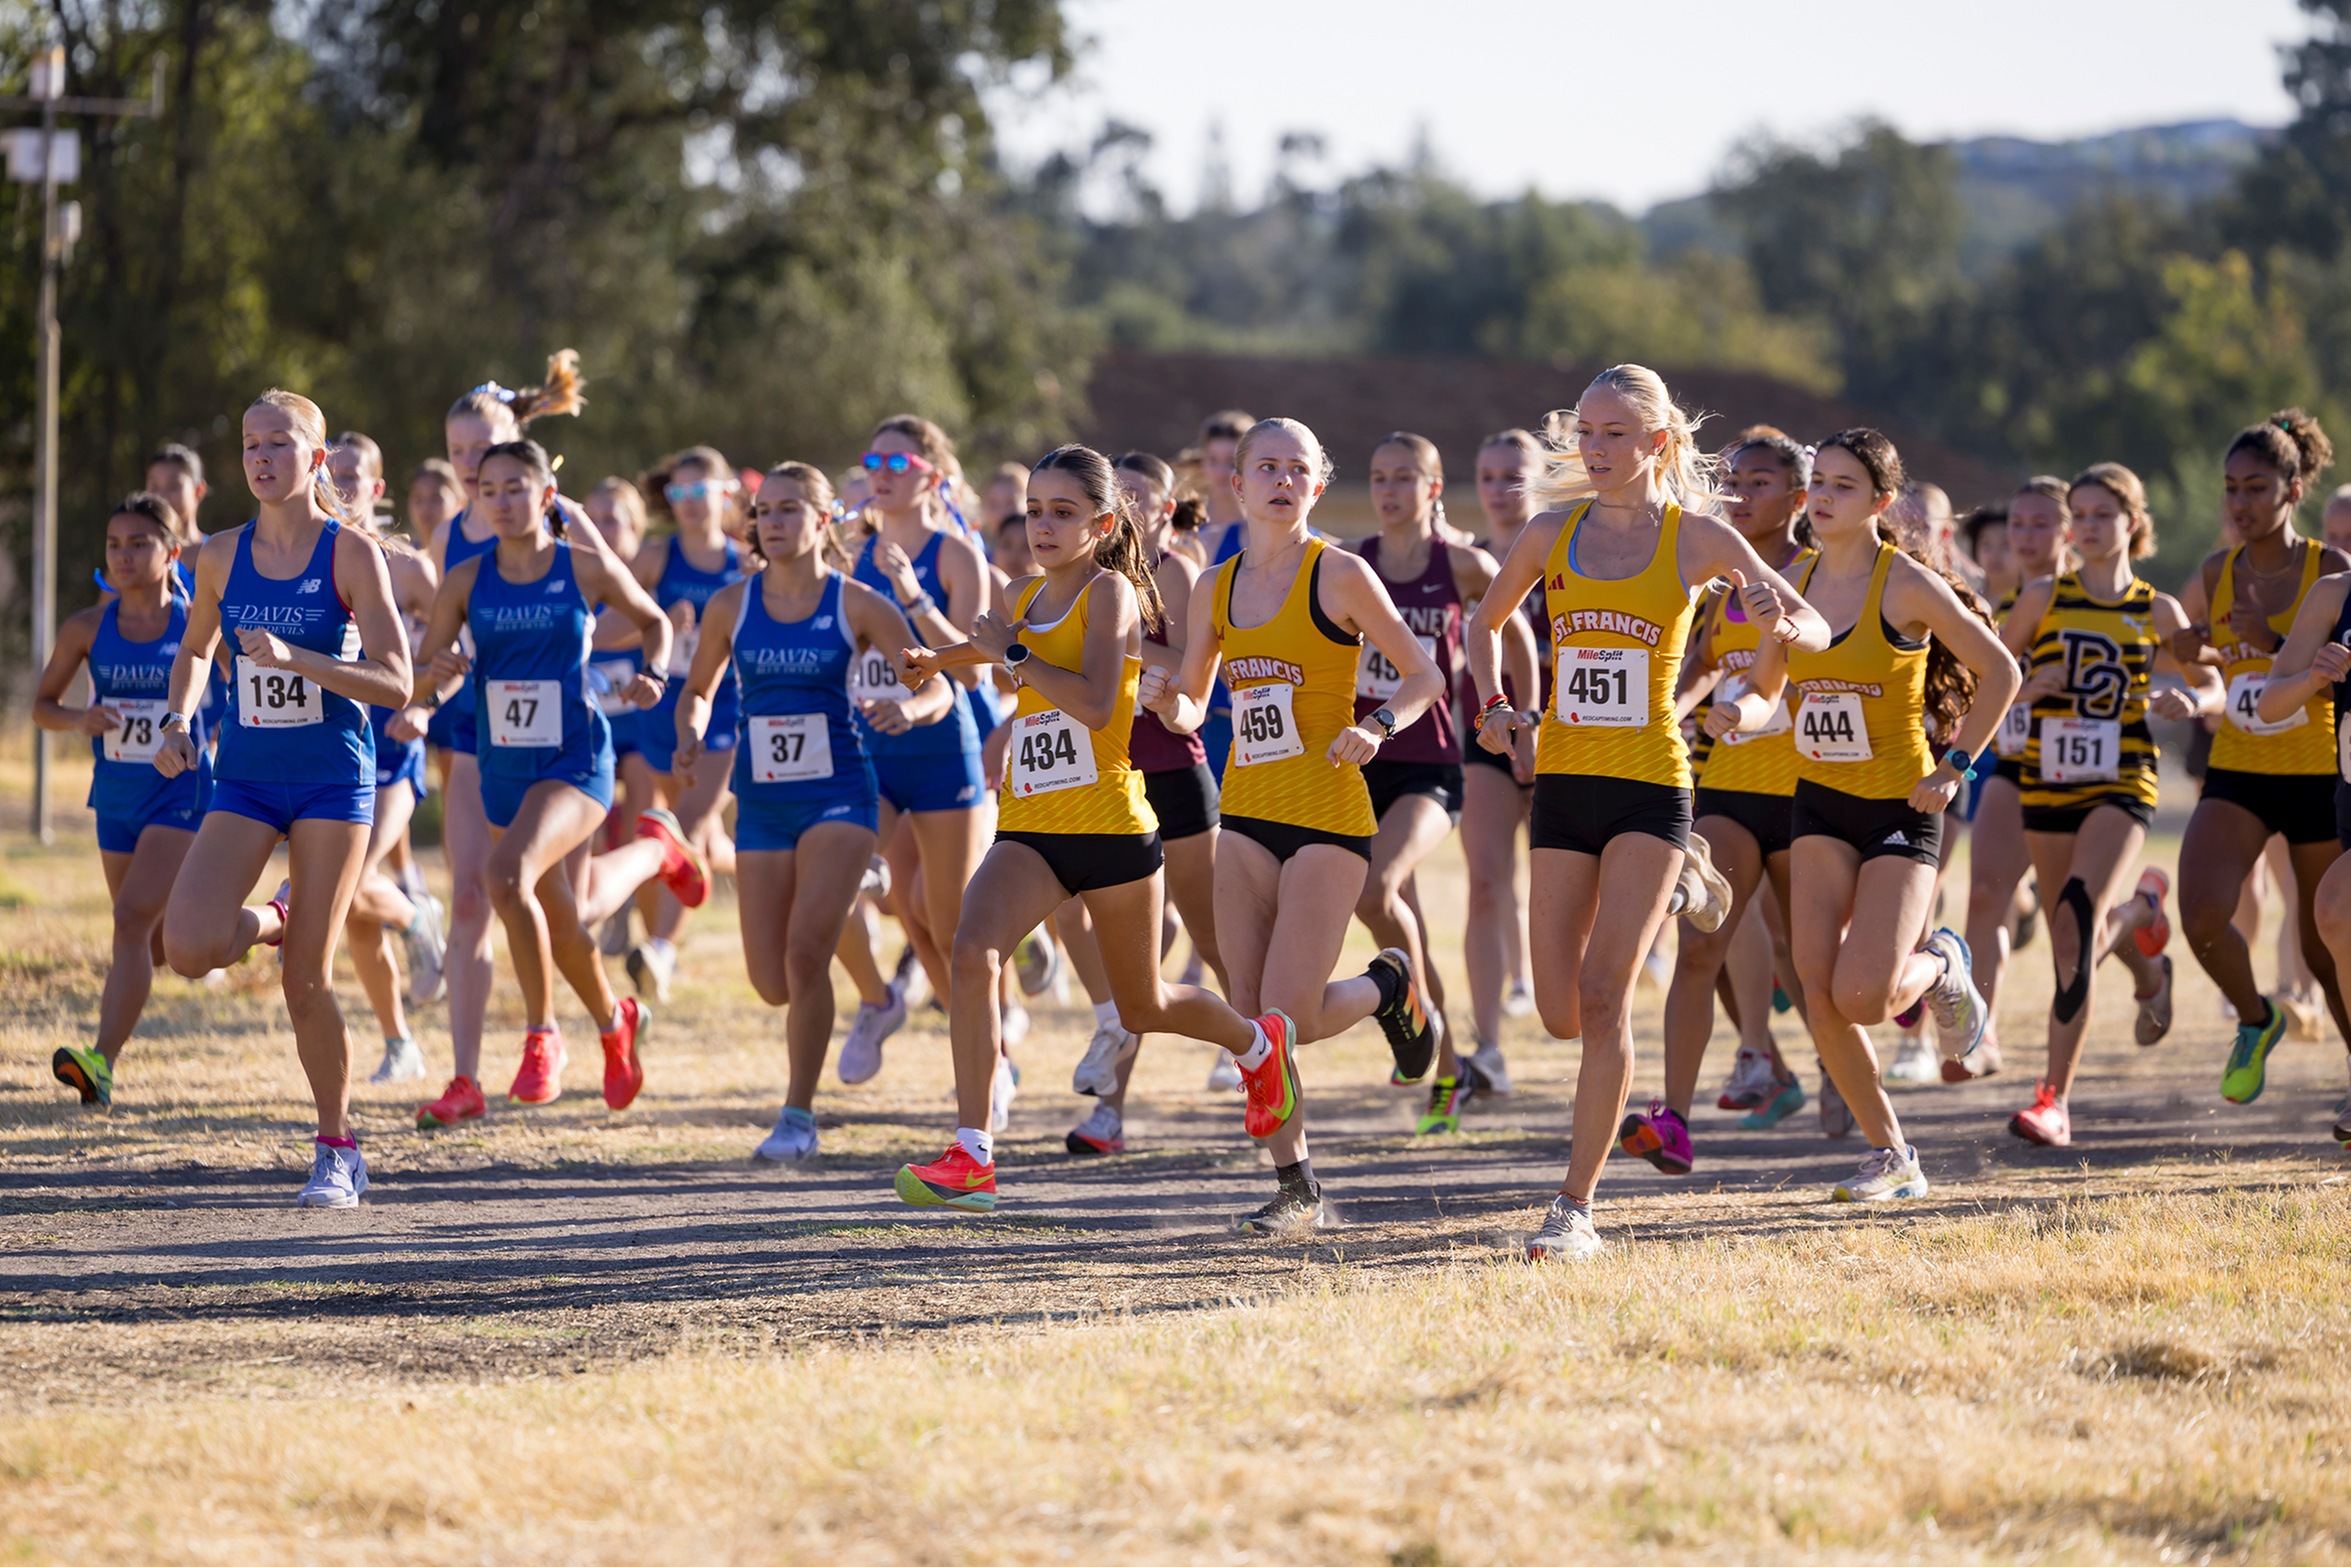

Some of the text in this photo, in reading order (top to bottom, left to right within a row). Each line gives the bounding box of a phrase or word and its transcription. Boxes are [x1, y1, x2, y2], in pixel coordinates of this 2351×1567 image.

[239, 604, 305, 623] DAVIS
[496, 604, 552, 622] DAVIS
[1553, 610, 1663, 647] ST. FRANCIS
[757, 647, 819, 664] DAVIS
[1576, 649, 1624, 662] MileSplit
[112, 664, 166, 680] DAVIS
[1228, 657, 1305, 687] FRANCIS
[1568, 667, 1627, 705] 451
[250, 675, 307, 709] 134
[505, 698, 539, 728] 47
[1024, 710, 1061, 728] MileSplit
[1240, 704, 1284, 743] 459
[1803, 710, 1854, 743] 444
[120, 717, 152, 745] 73
[770, 733, 806, 763] 37
[1020, 728, 1077, 773] 434
[2054, 735, 2104, 767] 151
